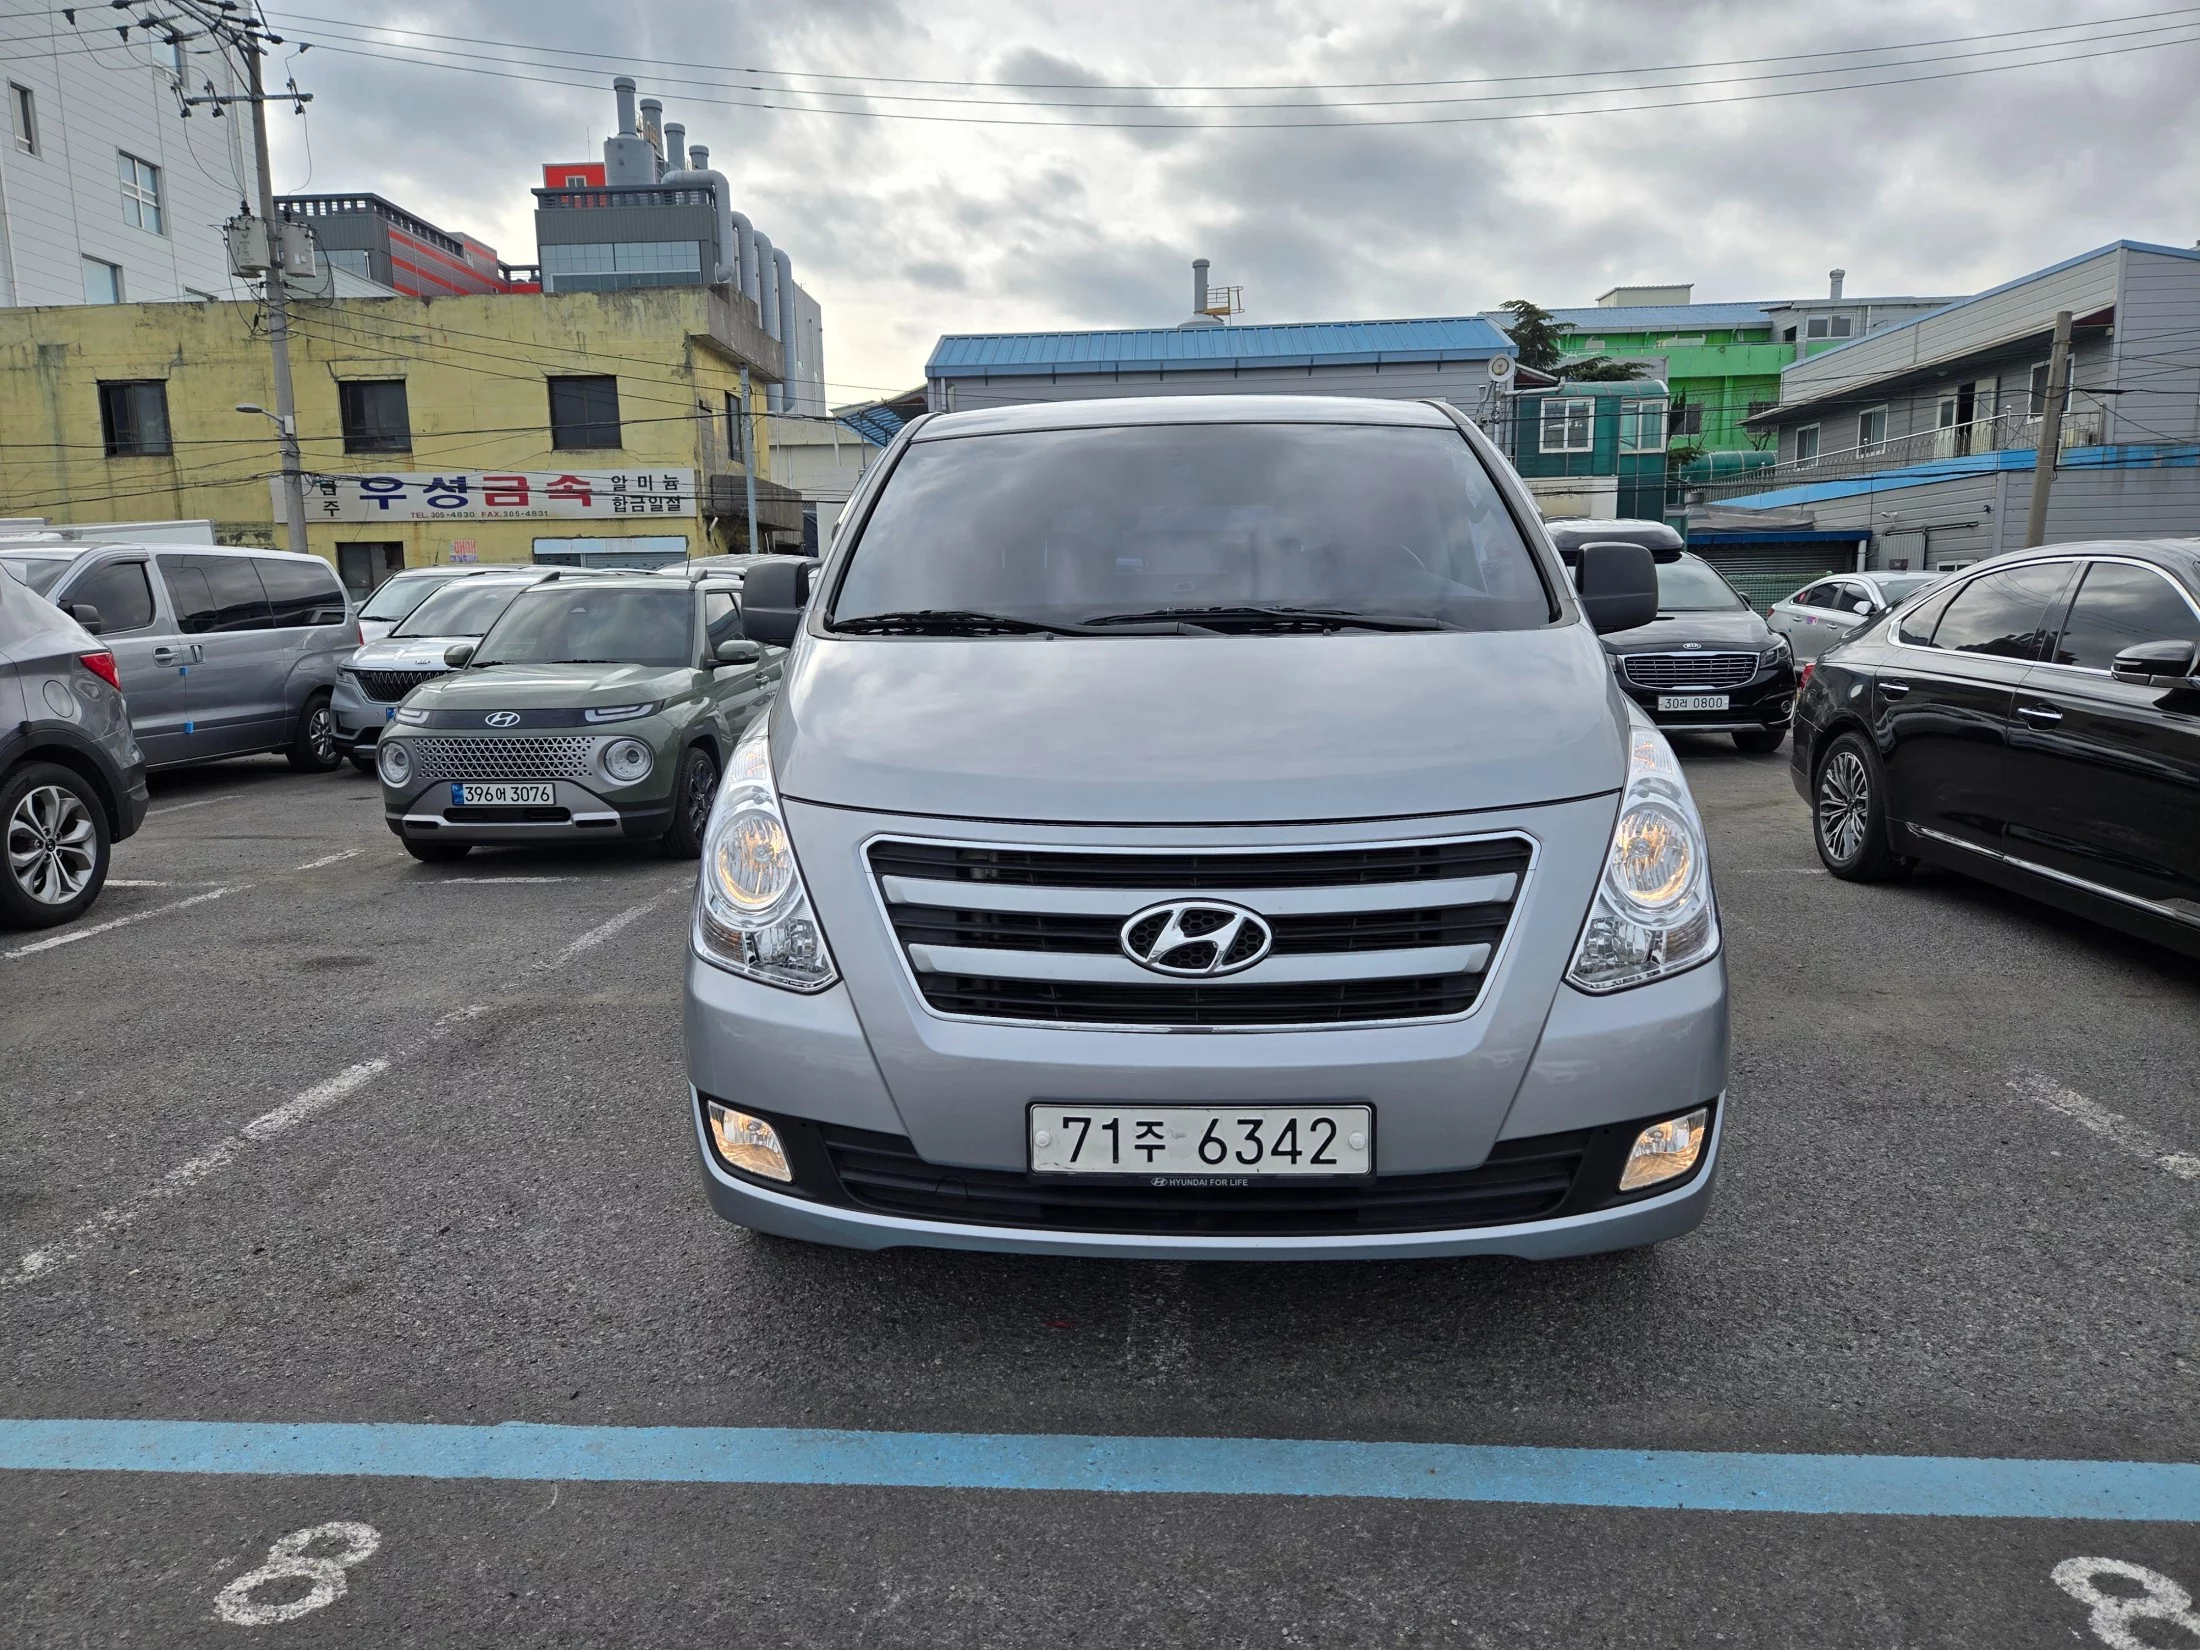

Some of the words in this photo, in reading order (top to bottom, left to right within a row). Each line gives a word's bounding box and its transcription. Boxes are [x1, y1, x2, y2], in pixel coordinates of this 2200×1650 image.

[611, 474, 680, 492] 알미늄
[359, 475, 593, 510] 우성금속
[430, 511, 476, 519] 305-4830
[503, 510, 549, 518] 305-4831
[1664, 697, 1688, 709] 30러
[1693, 697, 1723, 708] 0800
[465, 786, 506, 802] 396어
[510, 786, 550, 802] 3076
[1062, 1116, 1166, 1164] 71주
[1198, 1117, 1338, 1165] 6342
[1169, 1178, 1208, 1187] HYUNDAI
[1210, 1179, 1228, 1187] FOR
[1229, 1178, 1249, 1187] LIFE
[213, 1521, 382, 1627] 8
